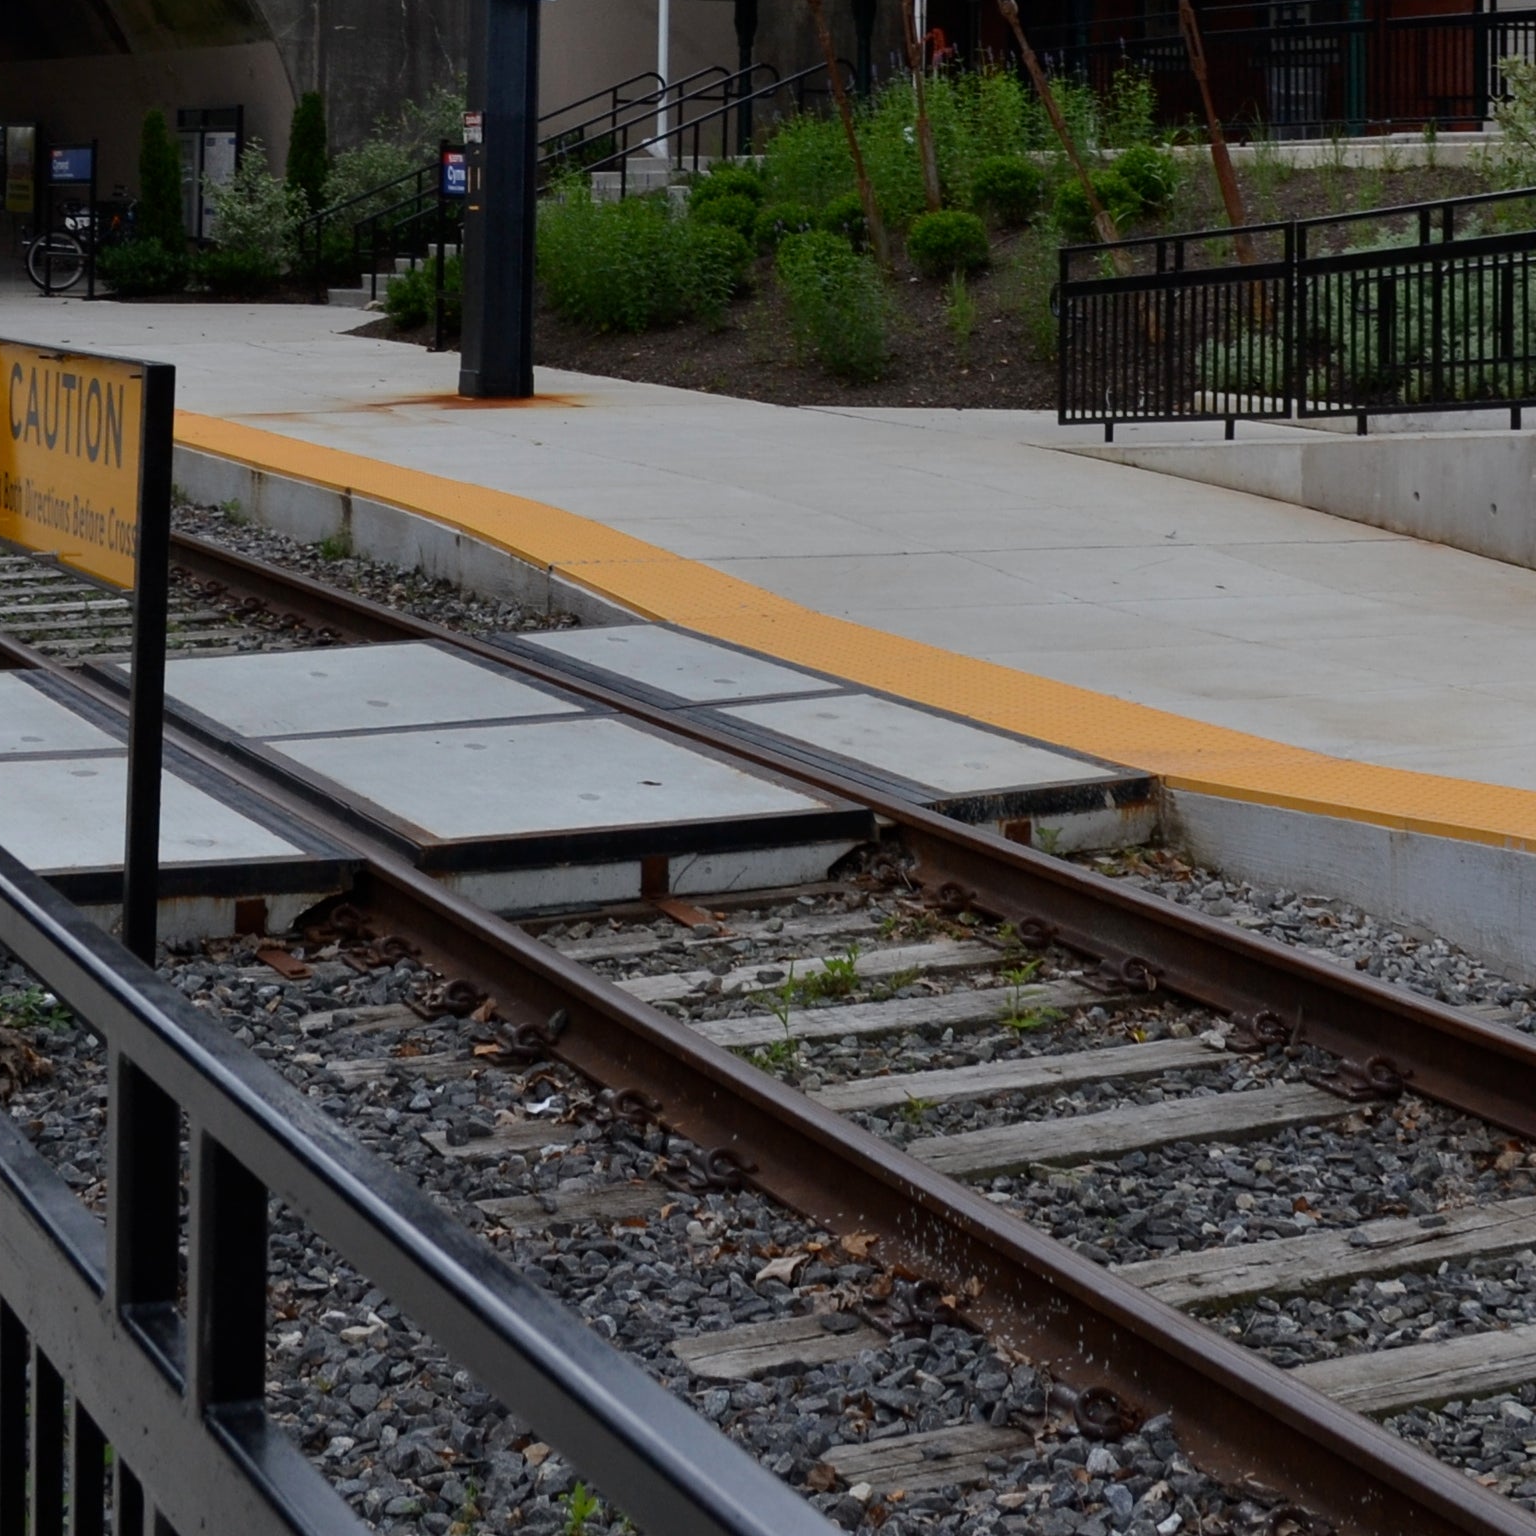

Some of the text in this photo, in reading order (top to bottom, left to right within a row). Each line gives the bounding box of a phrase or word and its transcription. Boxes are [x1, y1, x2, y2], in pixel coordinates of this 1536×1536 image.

[9, 362, 124, 469] CAUTION
[25, 478, 70, 534] Directions
[73, 494, 105, 547] Before
